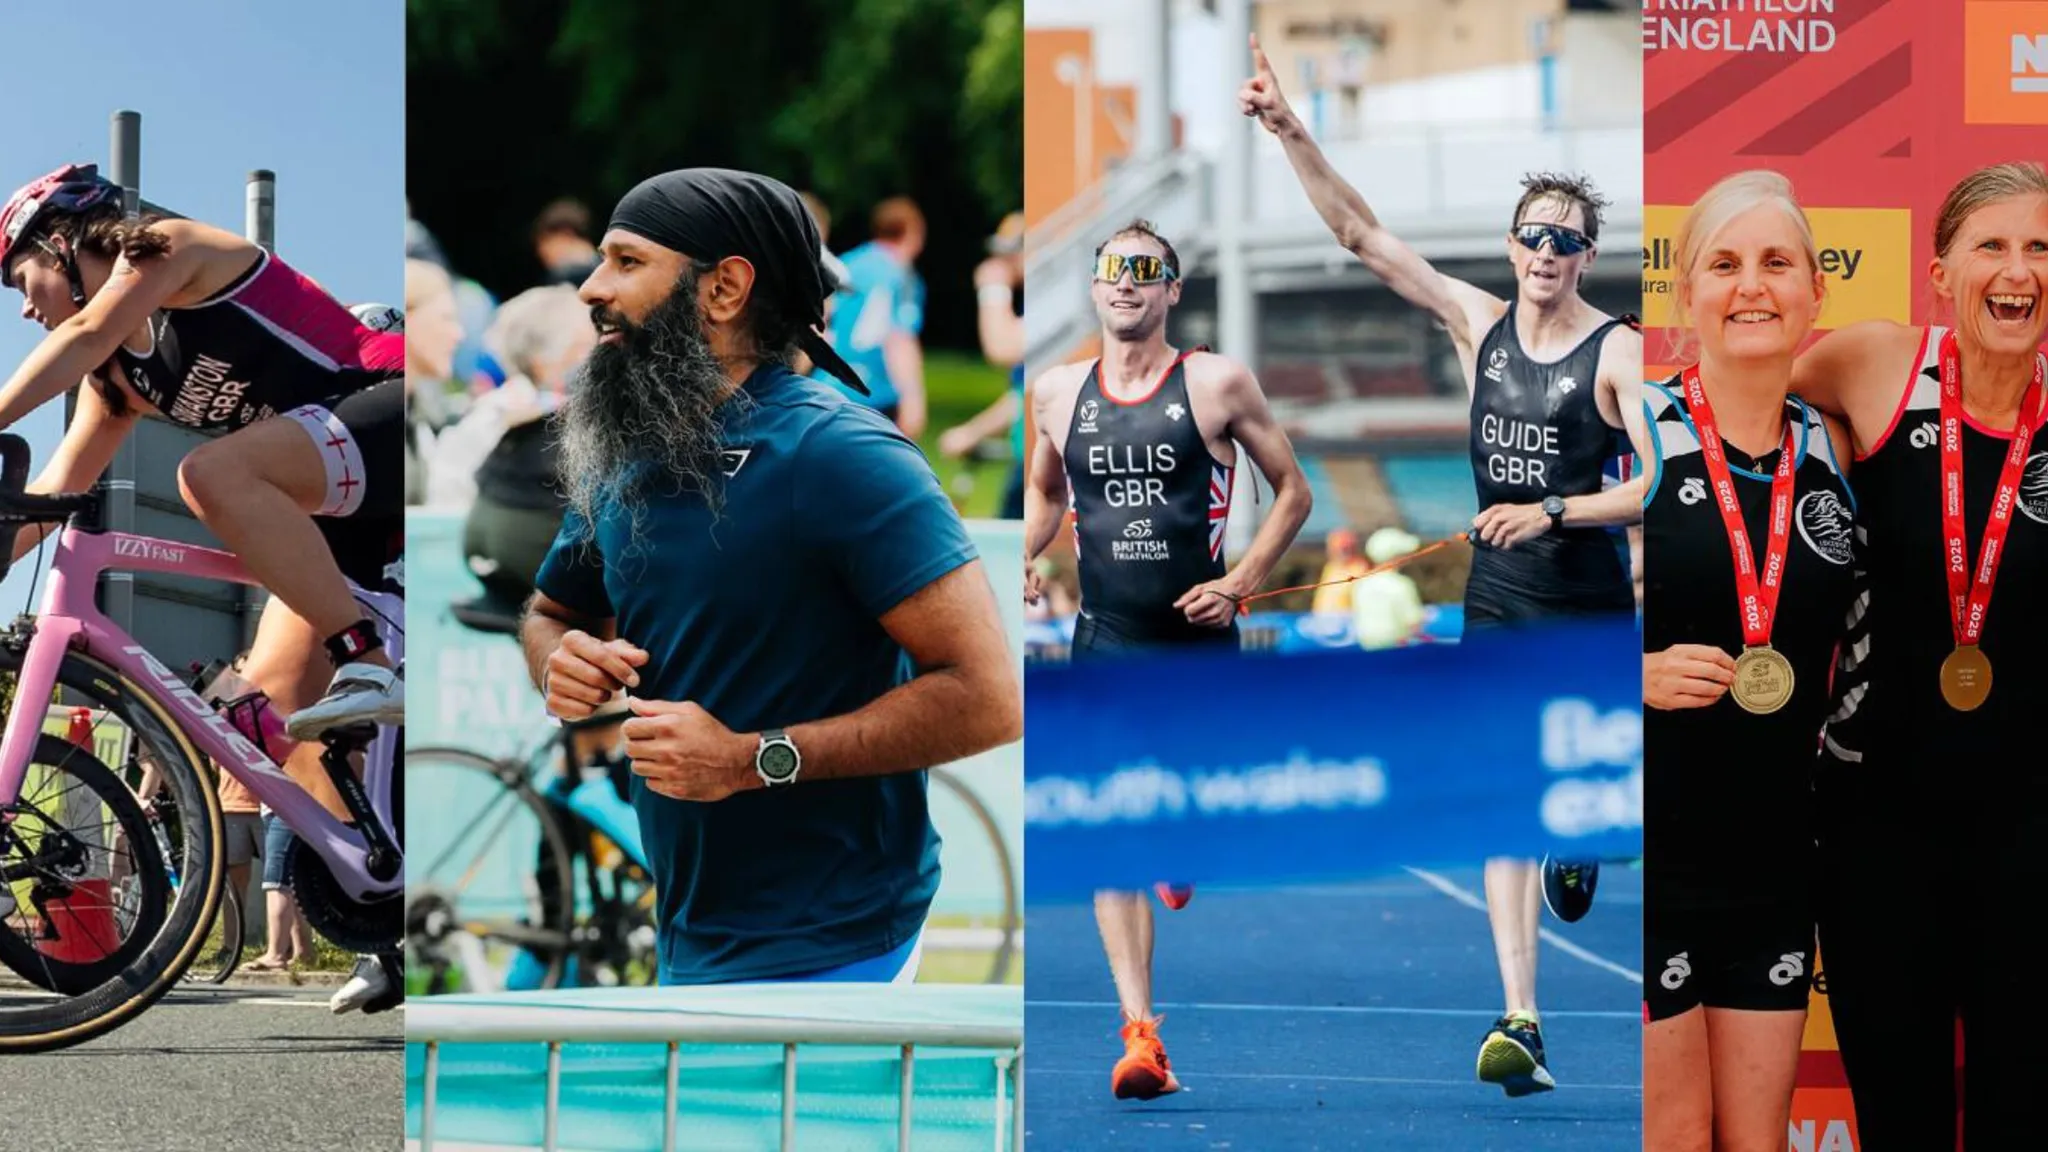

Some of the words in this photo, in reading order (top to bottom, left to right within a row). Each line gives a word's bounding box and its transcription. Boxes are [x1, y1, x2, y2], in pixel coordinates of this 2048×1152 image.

[207, 380, 252, 422] GBR
[1481, 413, 1560, 455] GUIDE
[1945, 417, 1959, 453] 2025
[1088, 443, 1177, 475] ELLIS
[1488, 453, 1548, 488] GBR
[1104, 478, 1168, 507] GBR
[1718, 480, 1737, 513] 2025
[1994, 484, 2013, 521] 2025
[1111, 540, 1168, 552] BRITISH
[1113, 551, 1170, 560] TRIATHLON
[1950, 537, 1964, 573] 2025
[1765, 552, 1781, 588] 2025
[1744, 595, 1760, 631] 2025
[1967, 603, 1984, 639] 2025
[122, 645, 296, 782] RIDLEY
